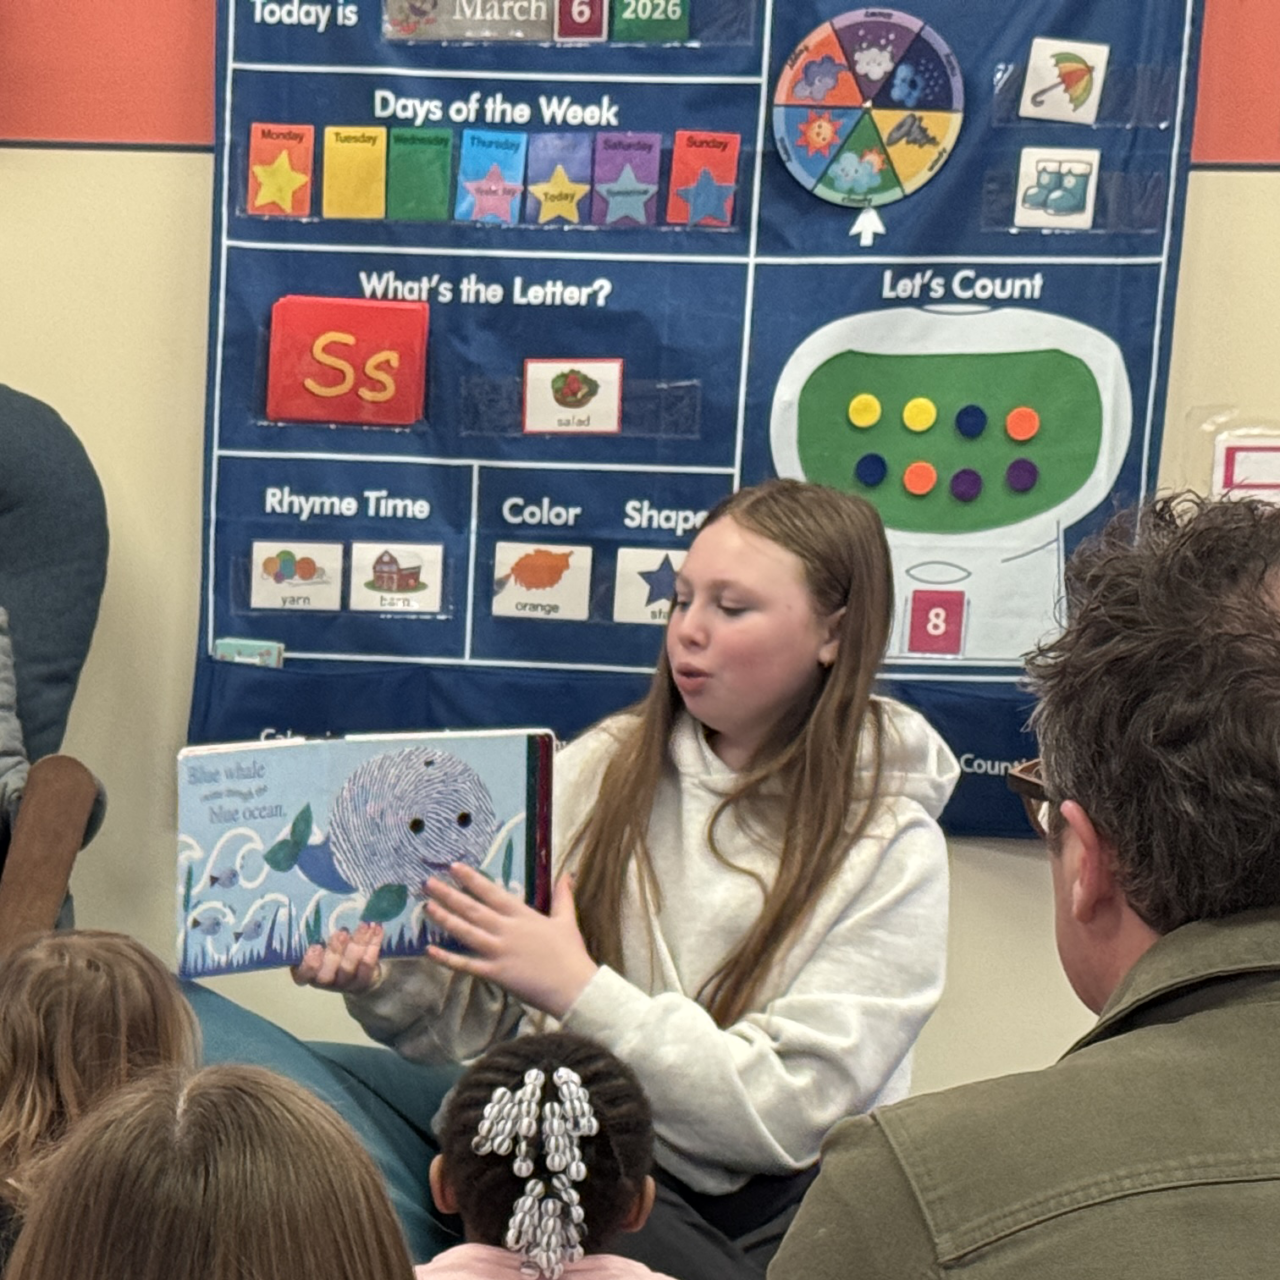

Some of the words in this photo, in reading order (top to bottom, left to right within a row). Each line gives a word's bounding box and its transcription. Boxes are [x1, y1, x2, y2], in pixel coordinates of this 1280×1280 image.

[251, 0, 331, 32] Today
[336, 0, 358, 26] is
[453, 0, 547, 21] March
[571, 0, 591, 23] 6
[622, 0, 682, 20] 2026
[374, 89, 443, 126] Days
[448, 91, 481, 123] of
[484, 92, 531, 124] the
[538, 94, 619, 126] Week
[261, 128, 305, 144] Monday
[333, 131, 378, 146] Tuesday
[393, 133, 450, 147] Wednesday
[470, 135, 521, 152] Thursday
[686, 136, 730, 152] Sunday
[603, 137, 653, 154] Saturday
[543, 190, 577, 203] Today
[359, 270, 453, 303] What's
[460, 273, 503, 304] the
[513, 276, 612, 307] Letter?
[882, 270, 945, 299] Let's
[952, 270, 1044, 300] Count
[303, 331, 400, 403] Ss
[557, 414, 590, 427] salad
[265, 486, 358, 521] Rhyme
[363, 490, 430, 519] Time
[502, 497, 582, 526] Color
[281, 595, 310, 607] yarn
[380, 595, 410, 607] barn
[515, 602, 559, 615] orange
[650, 608, 670, 620] sta
[926, 606, 947, 636] 8
[224, 760, 266, 780] whale
[242, 804, 287, 820] ocean.
